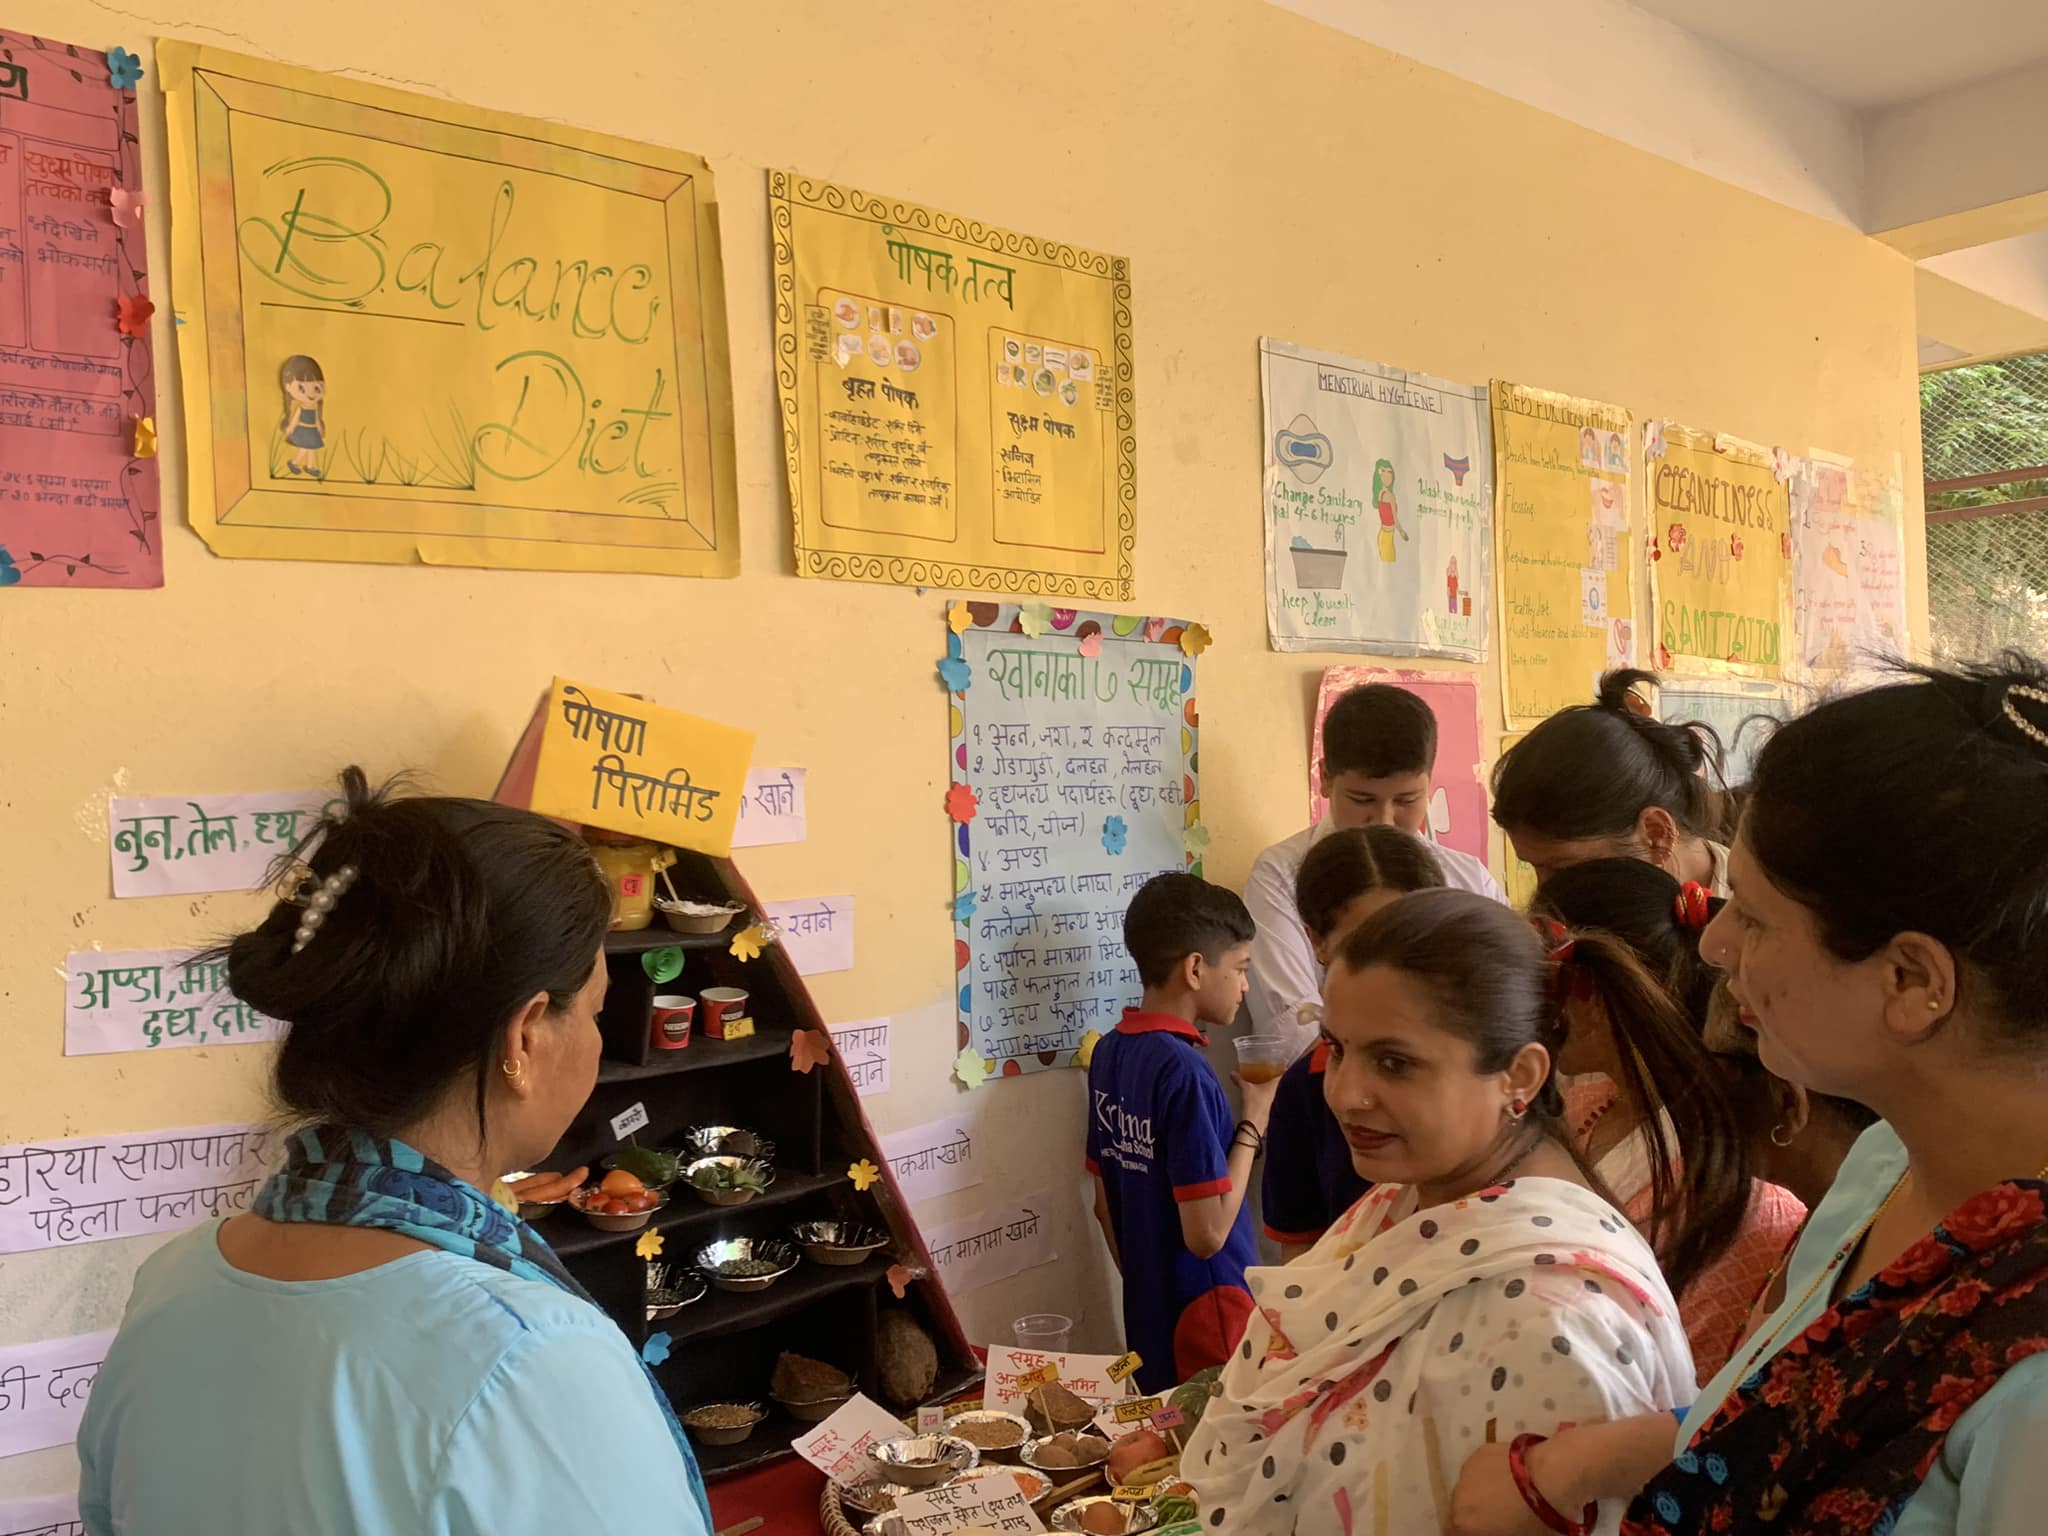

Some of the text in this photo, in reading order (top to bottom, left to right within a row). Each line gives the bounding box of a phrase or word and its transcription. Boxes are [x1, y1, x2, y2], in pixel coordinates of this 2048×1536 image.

[472, 350, 672, 482] Diet
[1319, 373, 1437, 414] MENSTRUAL HYGIENE
[562, 685, 647, 757] पोषण
[592, 753, 720, 823] पिरामिड
